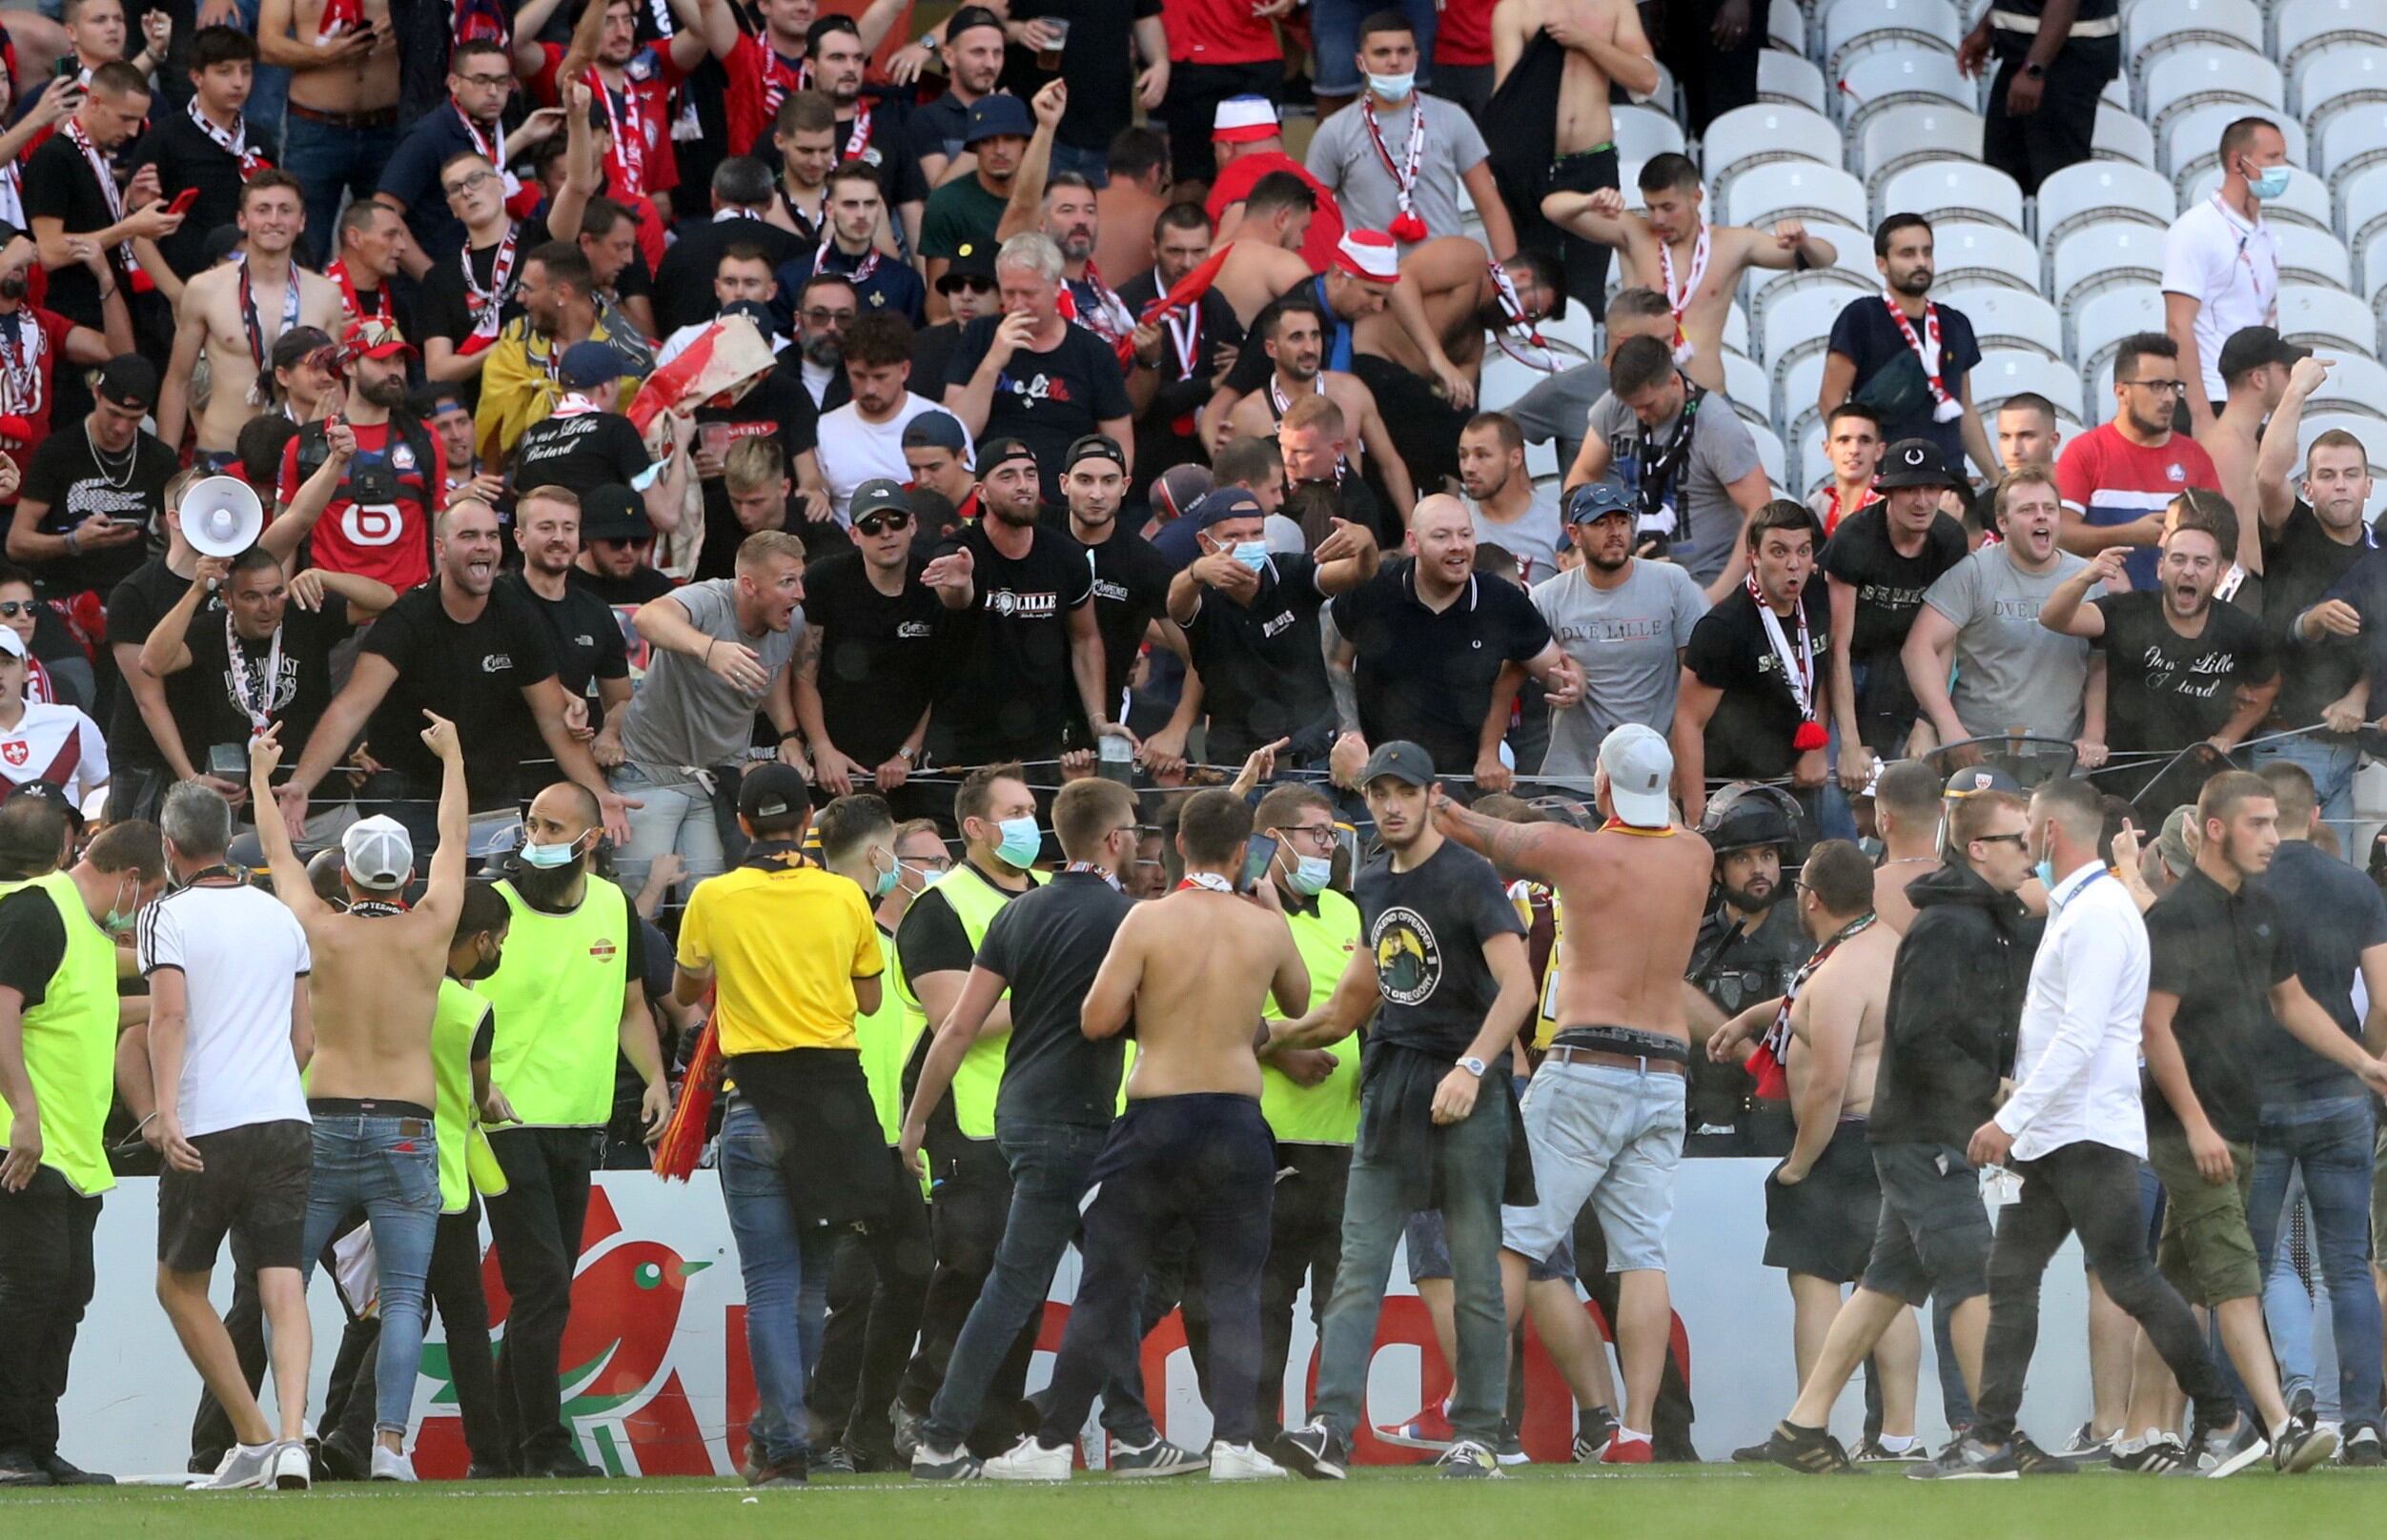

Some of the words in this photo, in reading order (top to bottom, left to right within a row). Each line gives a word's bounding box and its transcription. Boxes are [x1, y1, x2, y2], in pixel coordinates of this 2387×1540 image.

[1015, 595, 1056, 610] LILLE
[1561, 625, 1601, 642] DVE
[1607, 619, 1663, 639] LILLE
[2189, 651, 2234, 674] Lille
[1391, 972, 1434, 1002] GREGORY
